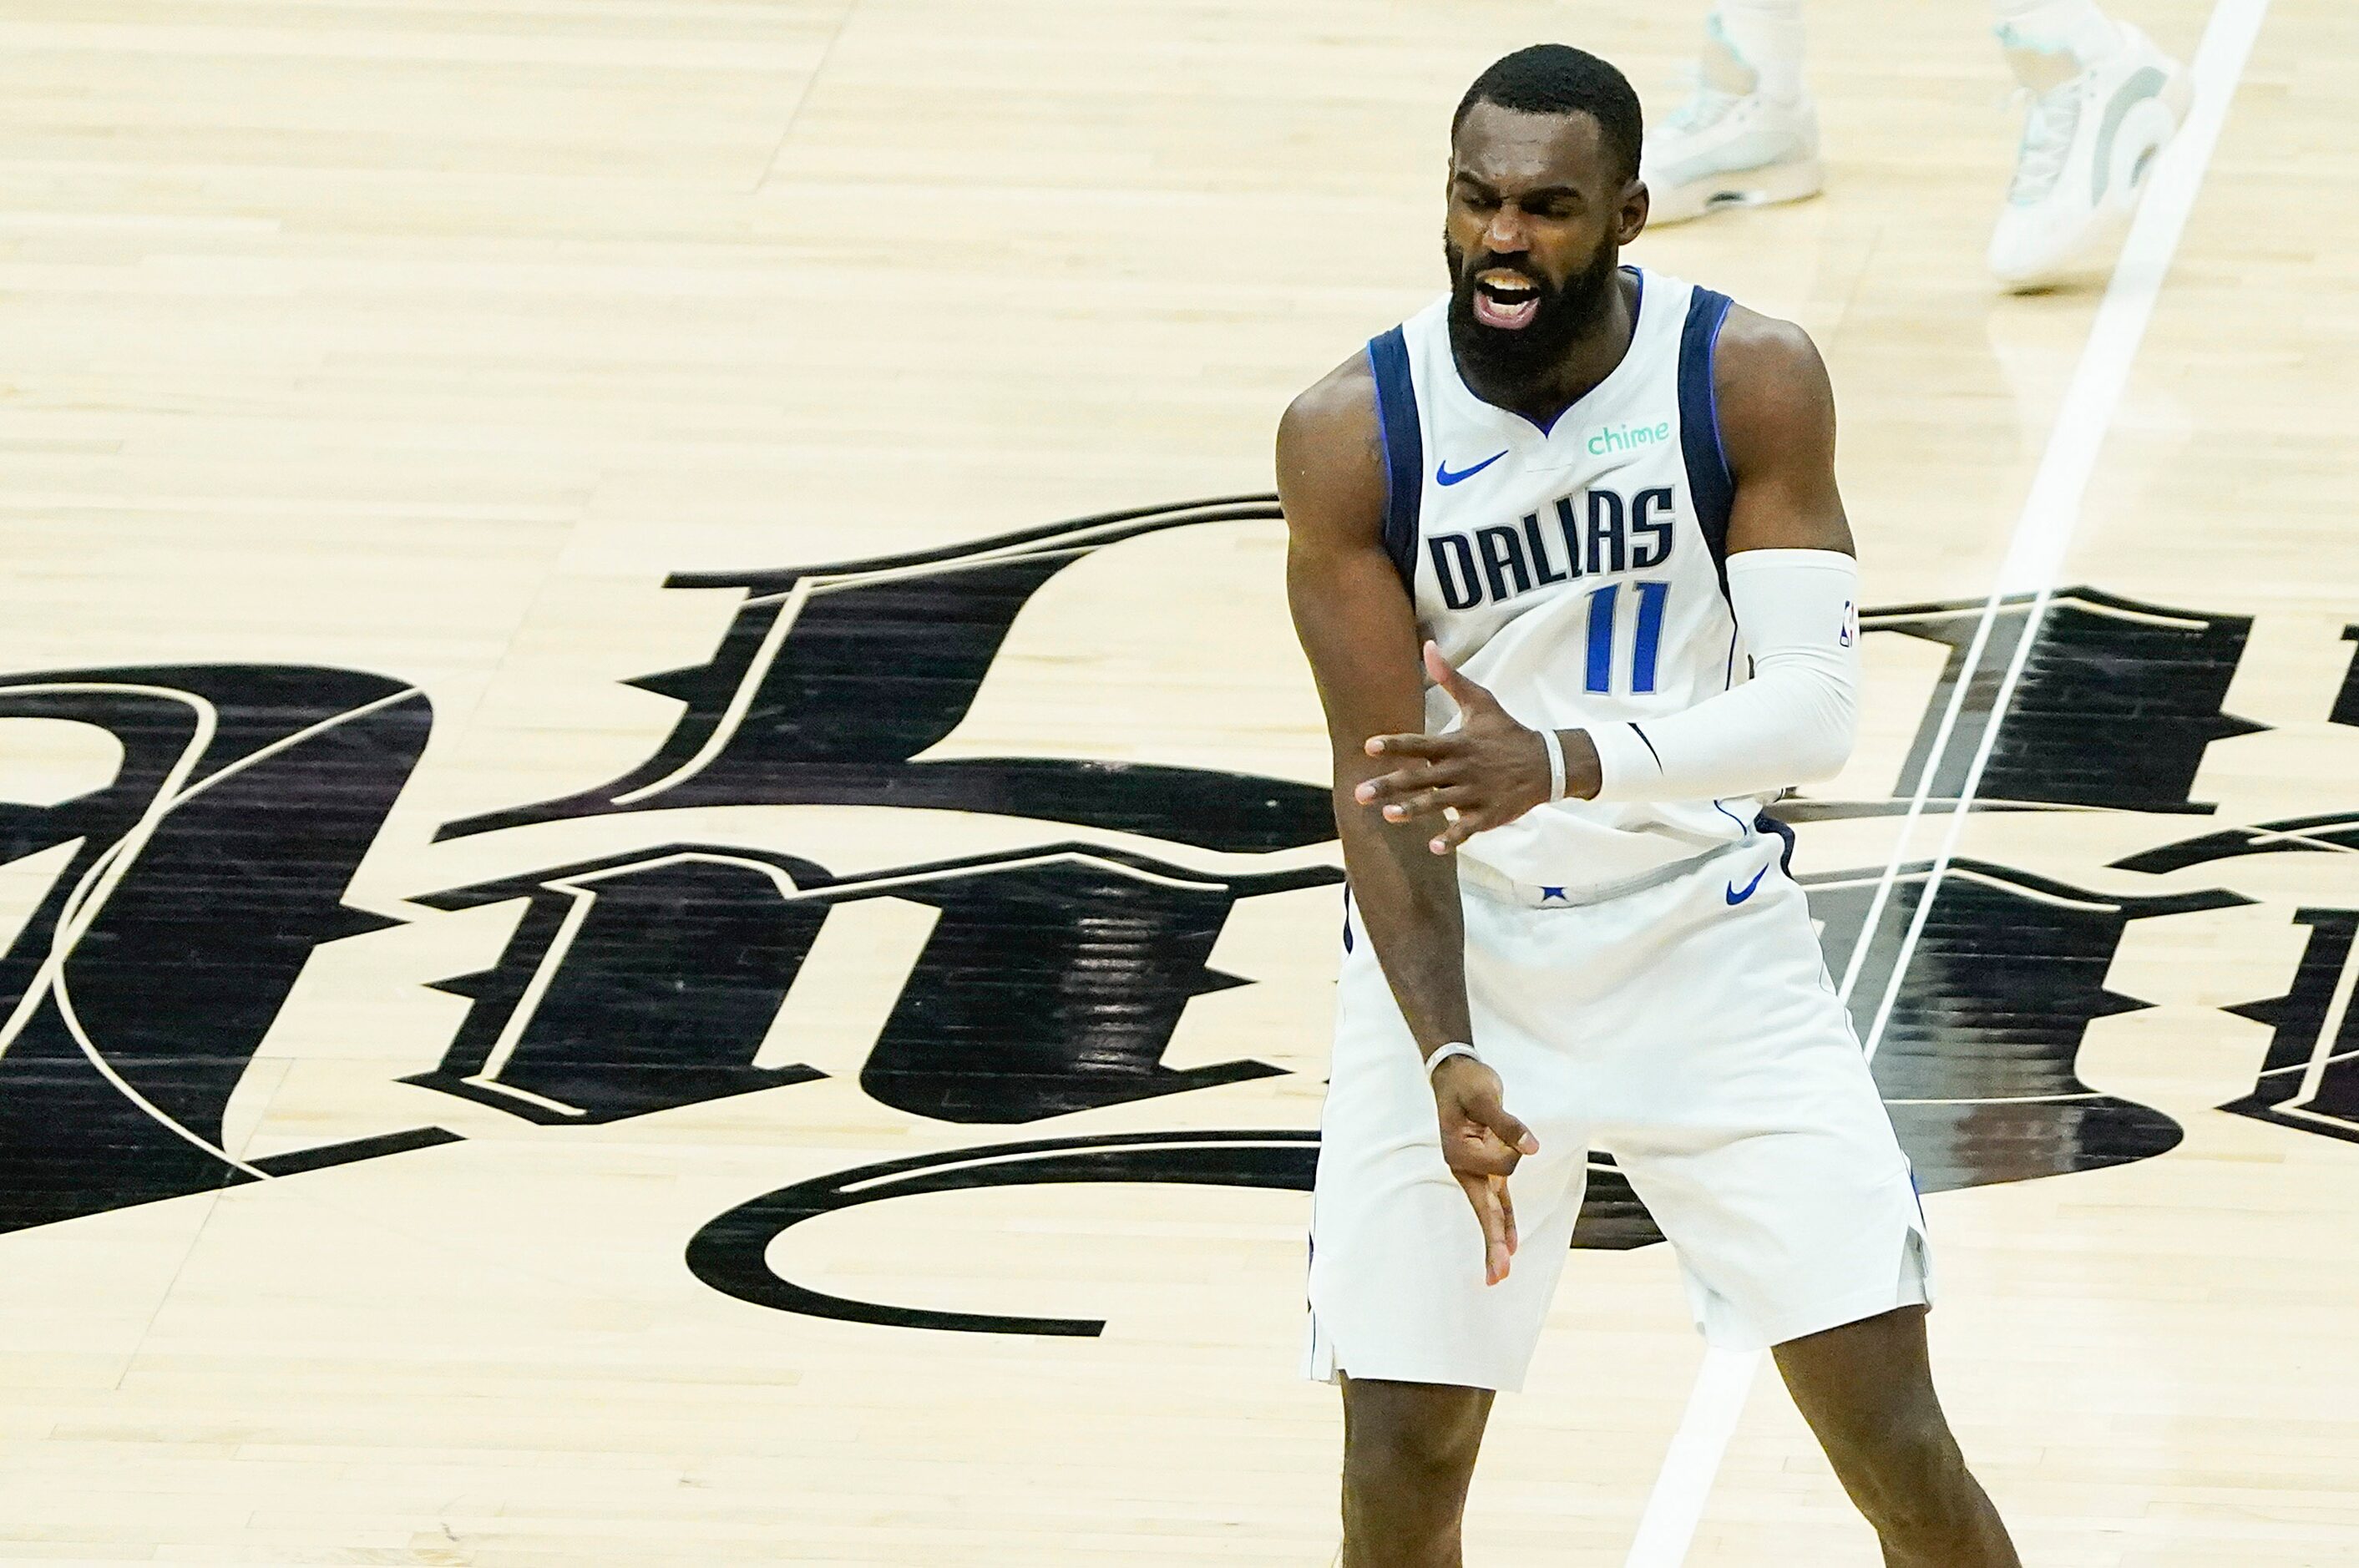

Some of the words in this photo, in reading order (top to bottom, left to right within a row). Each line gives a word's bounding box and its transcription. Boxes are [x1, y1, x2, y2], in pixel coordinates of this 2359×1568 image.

[1588, 422, 1669, 455] chime
[1425, 485, 1675, 611] DALLAS
[1583, 581, 1672, 695] 11
